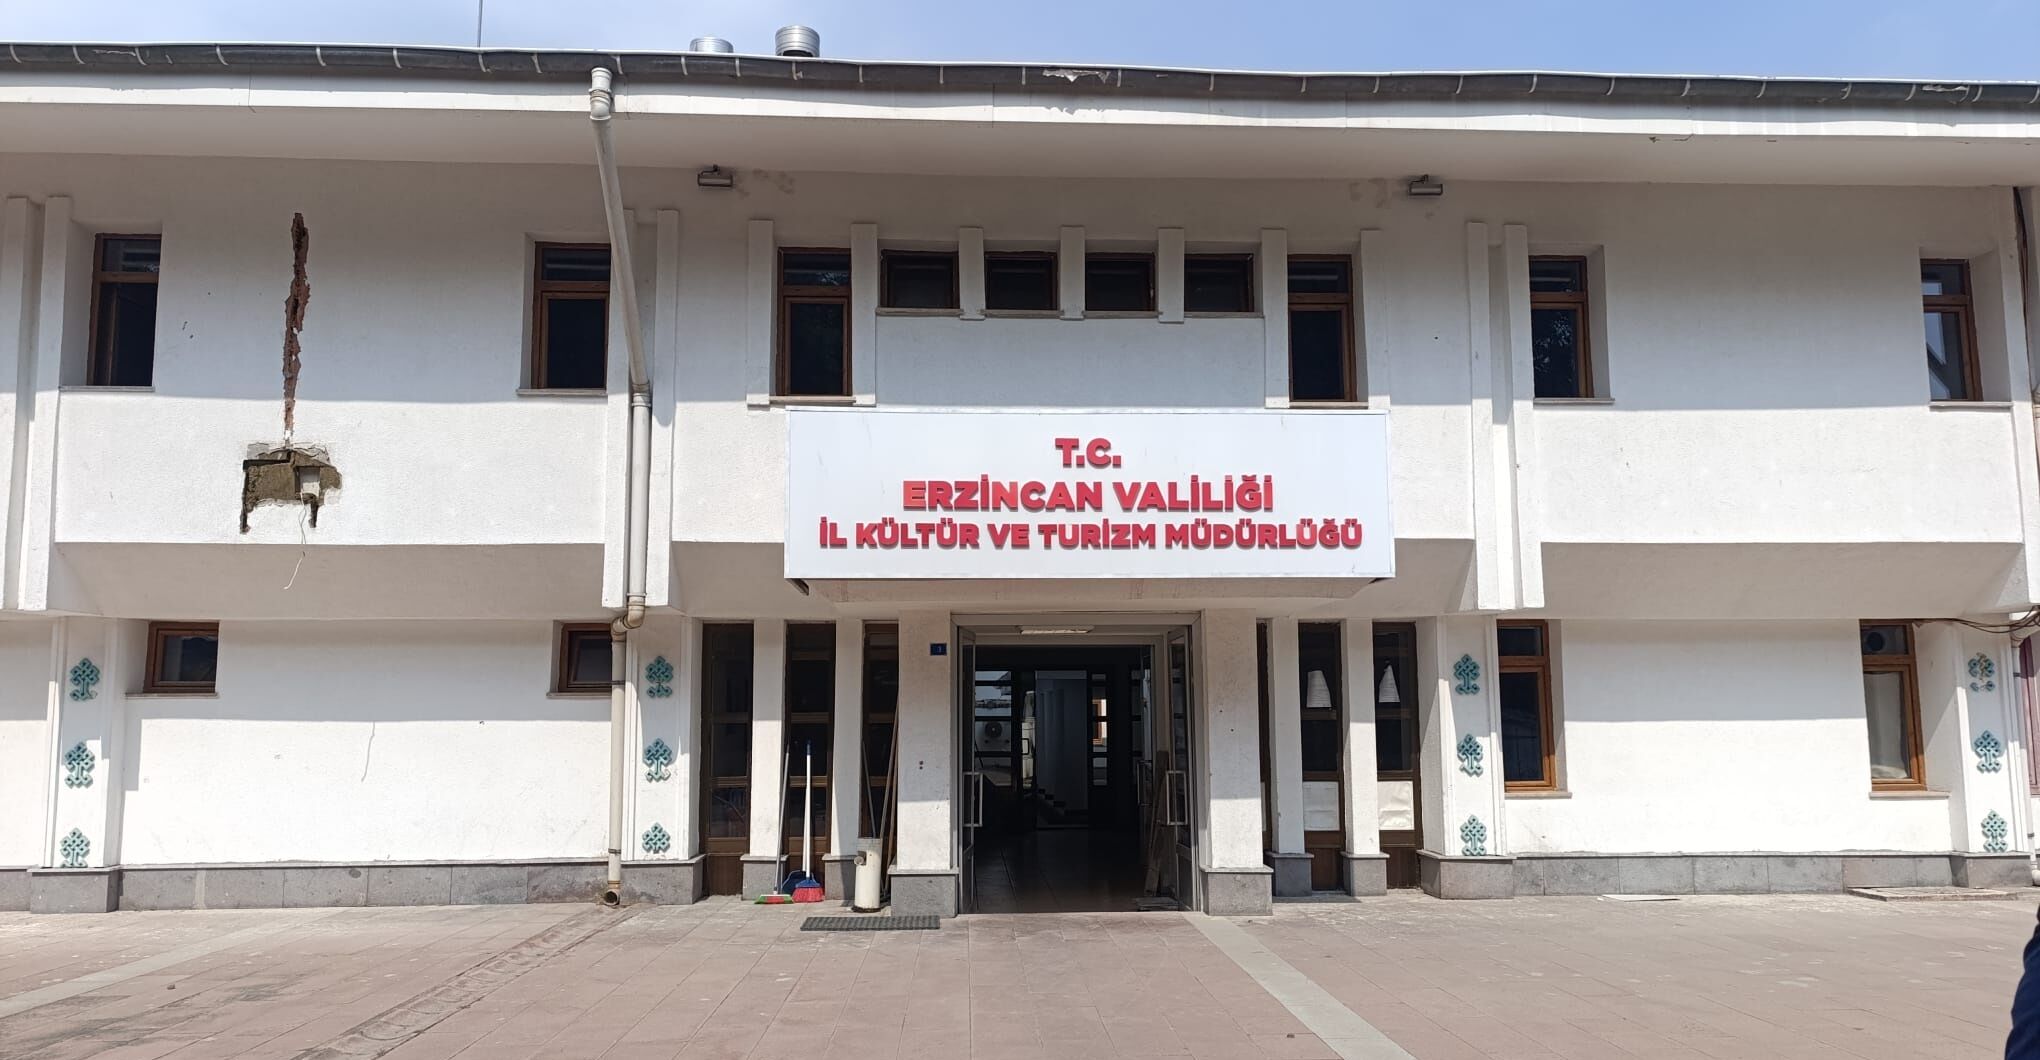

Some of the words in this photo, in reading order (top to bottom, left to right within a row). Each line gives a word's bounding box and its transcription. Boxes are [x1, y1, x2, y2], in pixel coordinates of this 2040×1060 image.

[1054, 437, 1122, 468] T.C.
[902, 474, 1104, 511] ERZİNCAN
[1112, 474, 1274, 511] VALİLİĞİ
[819, 516, 848, 548] İL
[855, 516, 981, 548] KÜLTÜR
[987, 522, 1031, 548] VE
[1037, 517, 1157, 549] TURİZM
[1164, 516, 1363, 549] MÜDÜRLÜĞÜ
